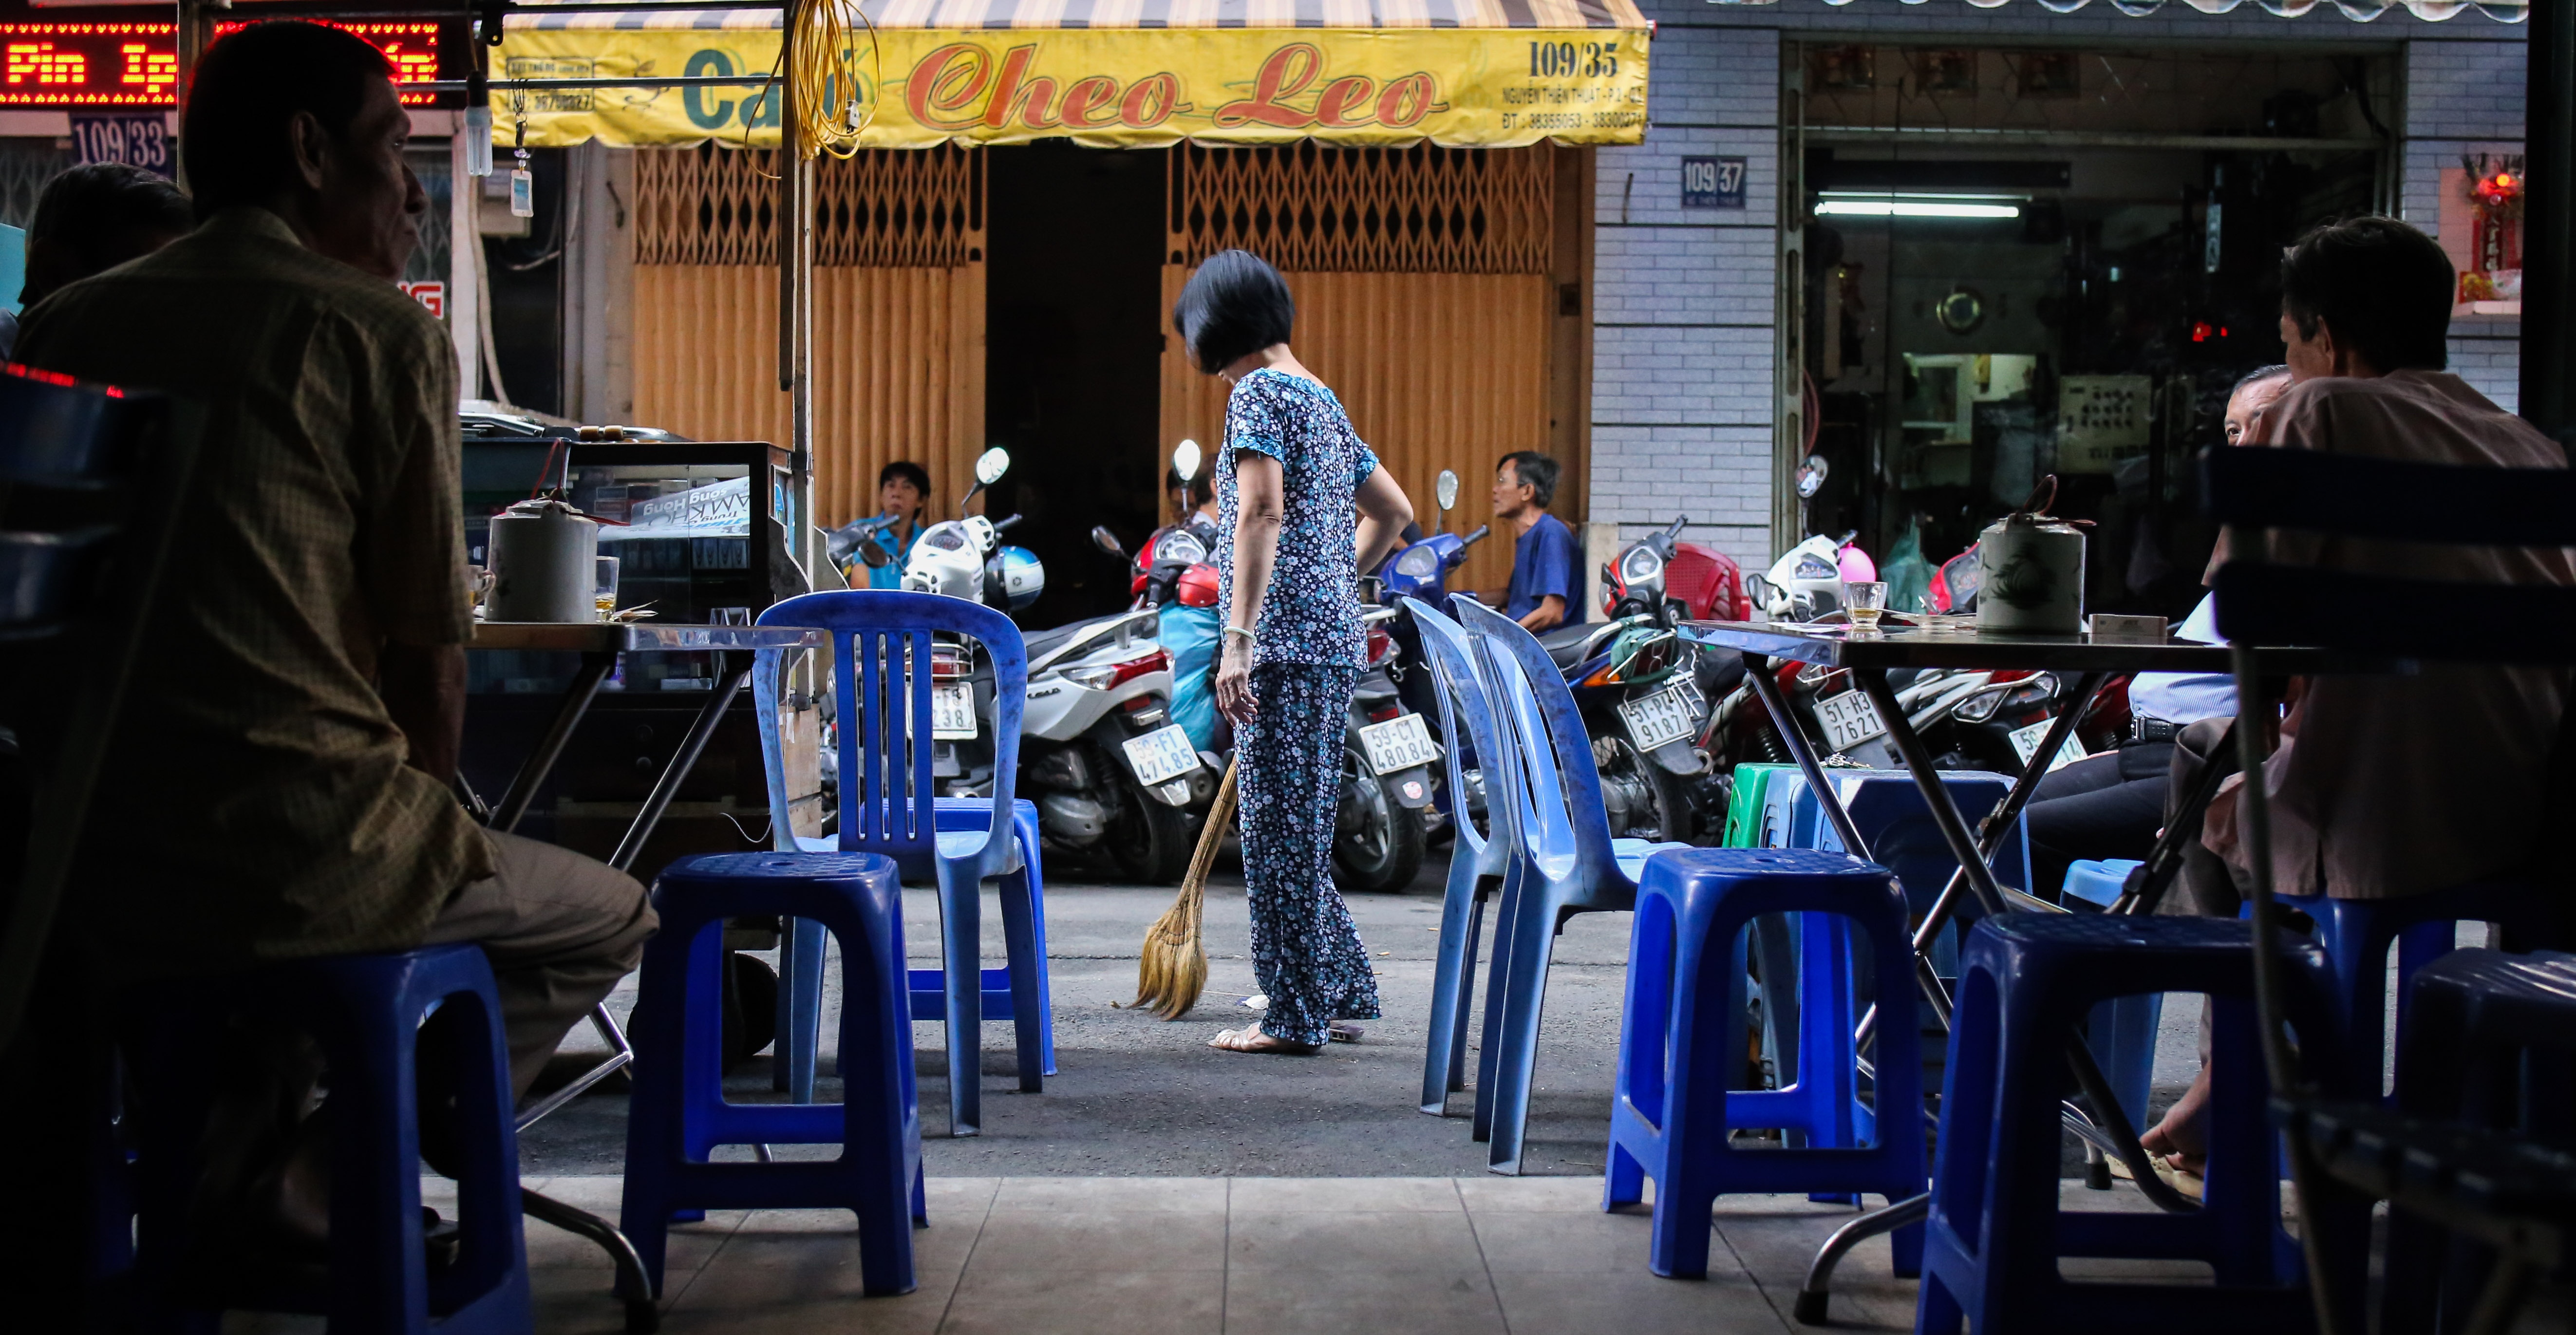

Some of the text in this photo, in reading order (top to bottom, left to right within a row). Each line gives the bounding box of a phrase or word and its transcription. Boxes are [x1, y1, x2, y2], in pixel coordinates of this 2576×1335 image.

[9, 43, 84, 83] Pin
[1529, 41, 1617, 77] 109/35
[904, 42, 1193, 131] Cheo
[1212, 42, 1450, 129] Leo
[75, 120, 166, 167] 109/33
[1685, 162, 1744, 193] 109/37
[1824, 692, 1871, 723] 51-H3
[1372, 720, 1415, 748] 59-C1
[1641, 713, 1681, 742] 9187
[1834, 713, 1880, 745] 7621
[1133, 732, 1177, 759] 59-F1
[1375, 740, 1430, 769] 480.84
[1139, 748, 1193, 780] 474.85
